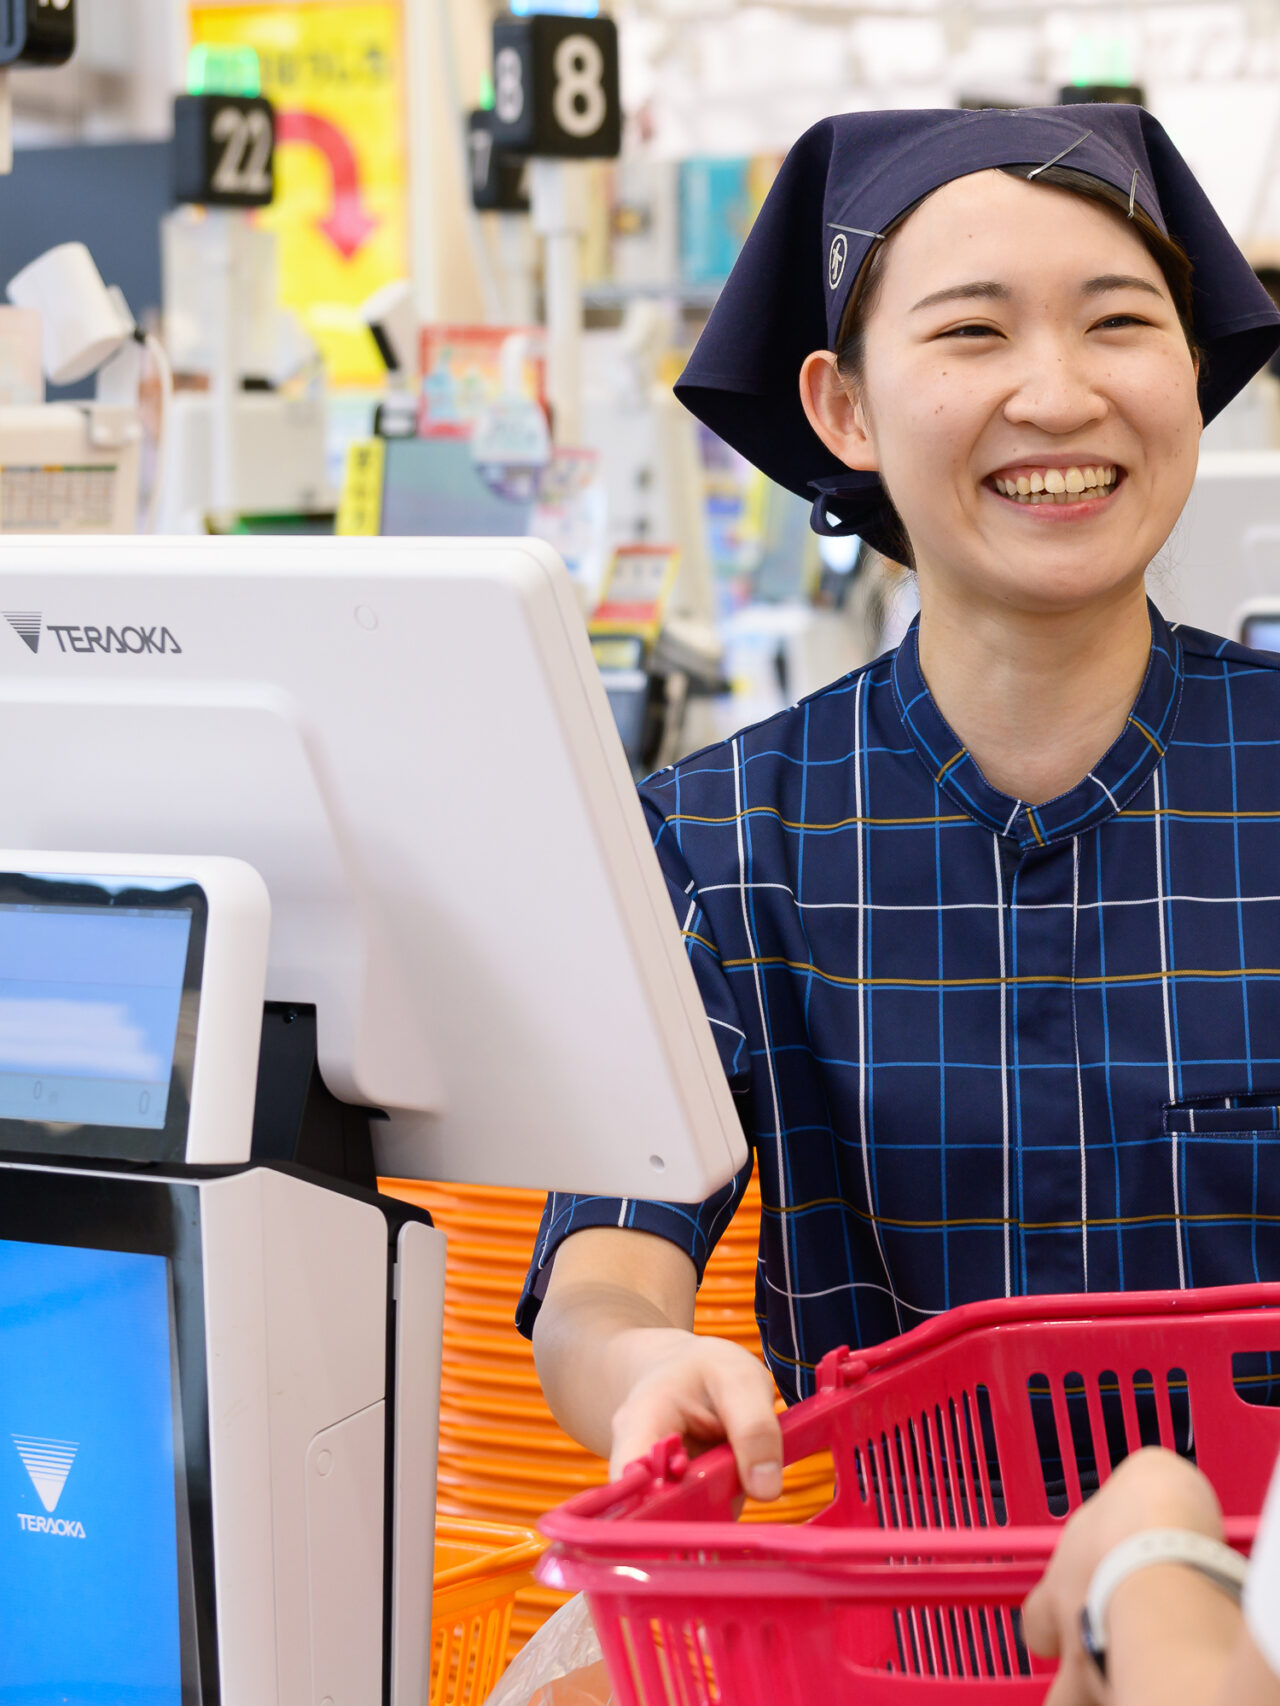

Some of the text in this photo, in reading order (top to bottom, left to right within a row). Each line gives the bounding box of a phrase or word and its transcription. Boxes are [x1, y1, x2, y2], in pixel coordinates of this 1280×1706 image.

[495, 47, 524, 124] 8
[553, 33, 607, 138] 8
[210, 106, 273, 194] 22
[46, 625, 182, 654] TERAOKA
[17, 1513, 86, 1538] TERAOKA
